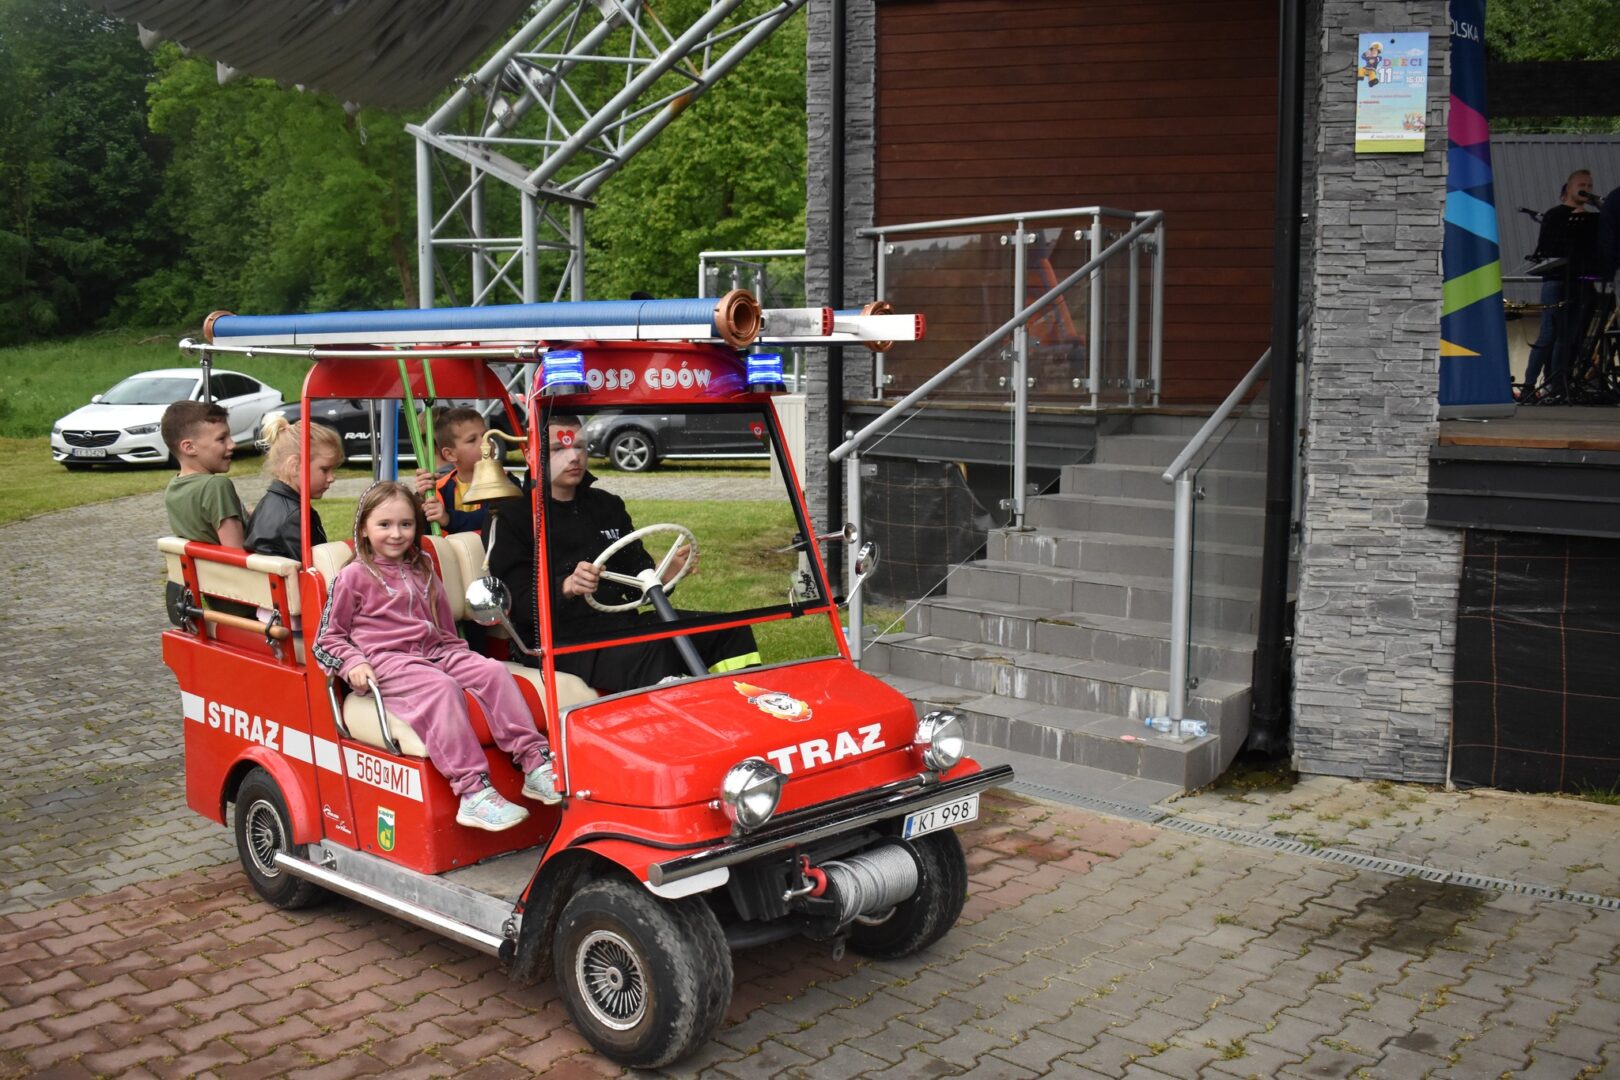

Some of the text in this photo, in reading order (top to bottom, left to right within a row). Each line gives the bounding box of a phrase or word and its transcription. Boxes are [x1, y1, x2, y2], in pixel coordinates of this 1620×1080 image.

[1379, 68, 1392, 84] 11
[585, 360, 711, 391] OSP GDÓW
[743, 723, 886, 775] TRAZ
[918, 801, 969, 832] K1 998
